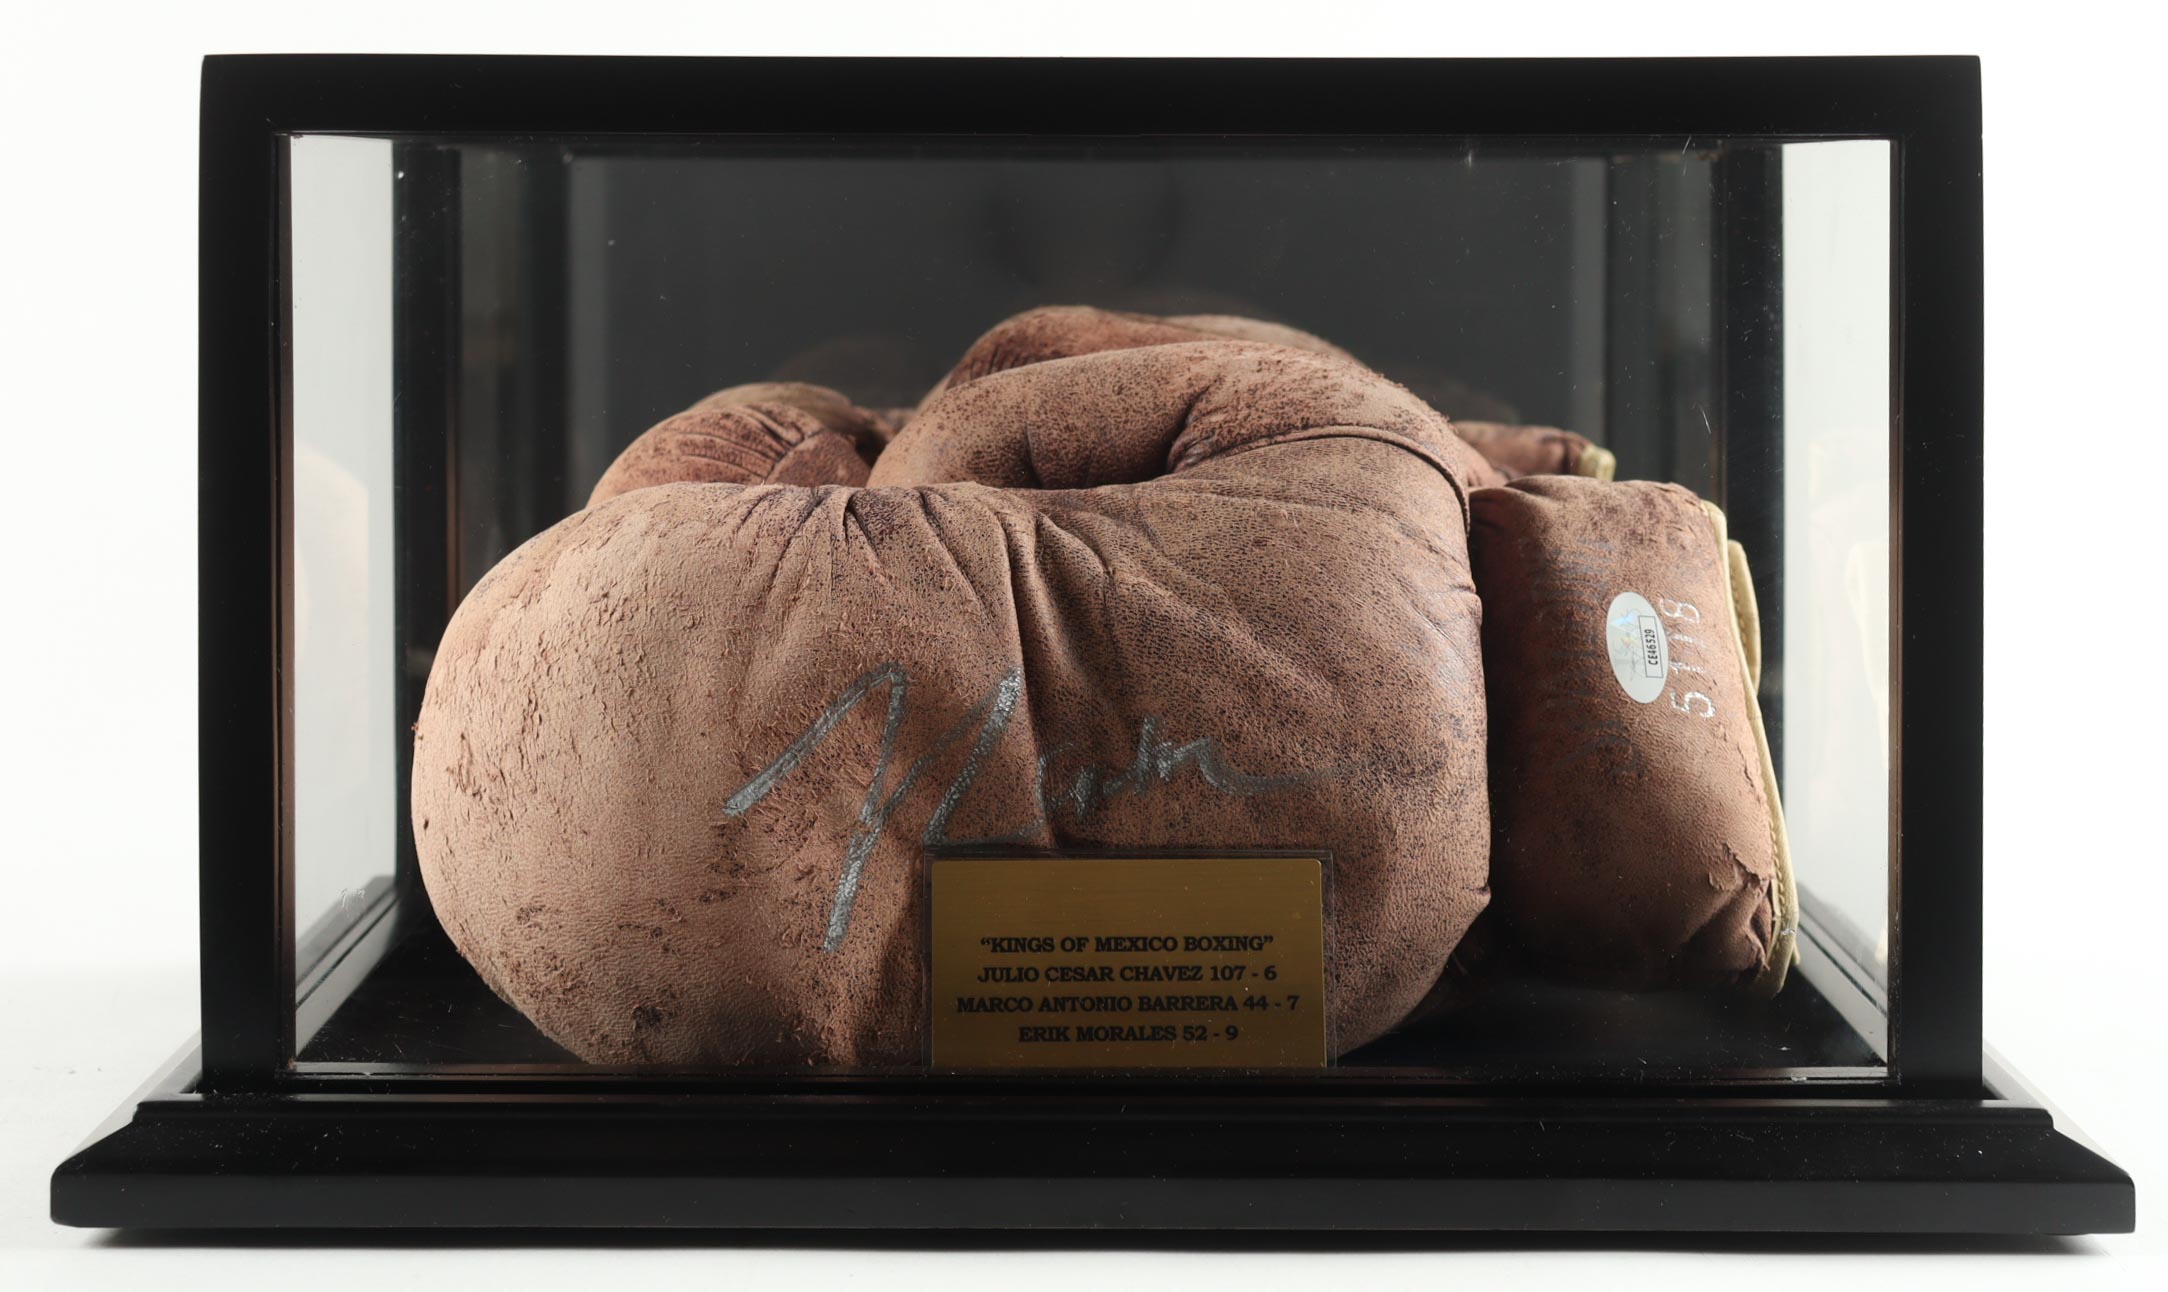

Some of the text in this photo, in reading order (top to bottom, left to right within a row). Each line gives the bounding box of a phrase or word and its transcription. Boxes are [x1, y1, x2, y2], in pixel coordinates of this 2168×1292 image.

[1644, 628, 1659, 666] CE46529
[981, 935, 1274, 953] “KINGS OF MEXICO BOXING”
[977, 967, 1040, 983] JULIO
[1045, 967, 1115, 983] CESAR
[1120, 966, 1204, 982] CHAVEZ
[1210, 965, 1247, 982] 107
[1264, 965, 1278, 981] 6
[957, 997, 1034, 1014] MARCO
[1038, 997, 1133, 1013] ANTONIO
[1138, 996, 1239, 1012] BARRERA
[1243, 995, 1270, 1011] 44
[1287, 995, 1301, 1011] 7
[1018, 1027, 1071, 1043] ERIK
[1076, 1026, 1177, 1042] MORALES
[1183, 1026, 1208, 1041] 52
[1225, 1026, 1240, 1041] 9
